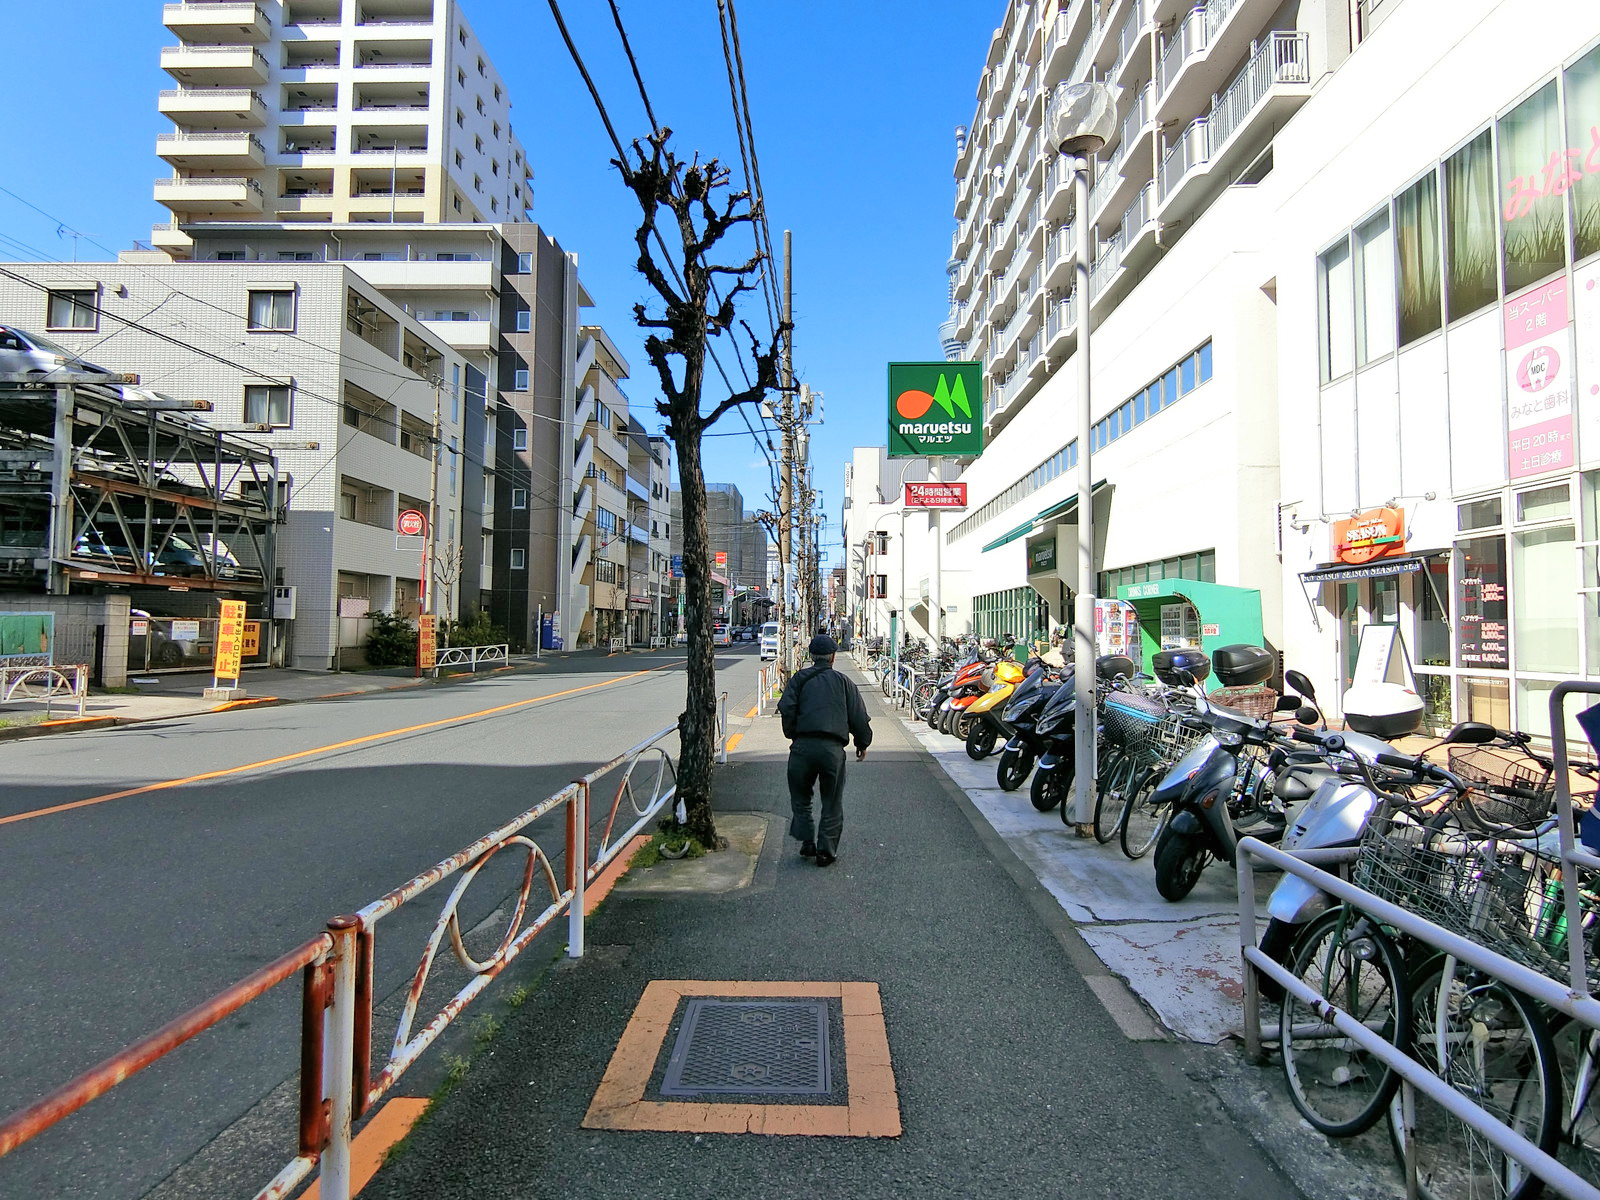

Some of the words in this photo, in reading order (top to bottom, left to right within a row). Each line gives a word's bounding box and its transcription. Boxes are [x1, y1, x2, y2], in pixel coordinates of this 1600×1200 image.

[1508, 288, 1564, 321] 当スーパー
[1524, 312, 1547, 332] 2階
[1530, 362, 1546, 376] MDC
[1510, 390, 1569, 419] みなと歯科
[899, 421, 971, 434] maruetsu
[918, 435, 953, 443] マルエツ
[1520, 454, 1562, 471] 土日診療
[910, 485, 961, 497] 24時間営業
[1346, 524, 1388, 542] SEASON
[1370, 565, 1401, 576] SEASON
[218, 605, 236, 672] 駐車禁止
[421, 618, 431, 665] 駐車禁止
